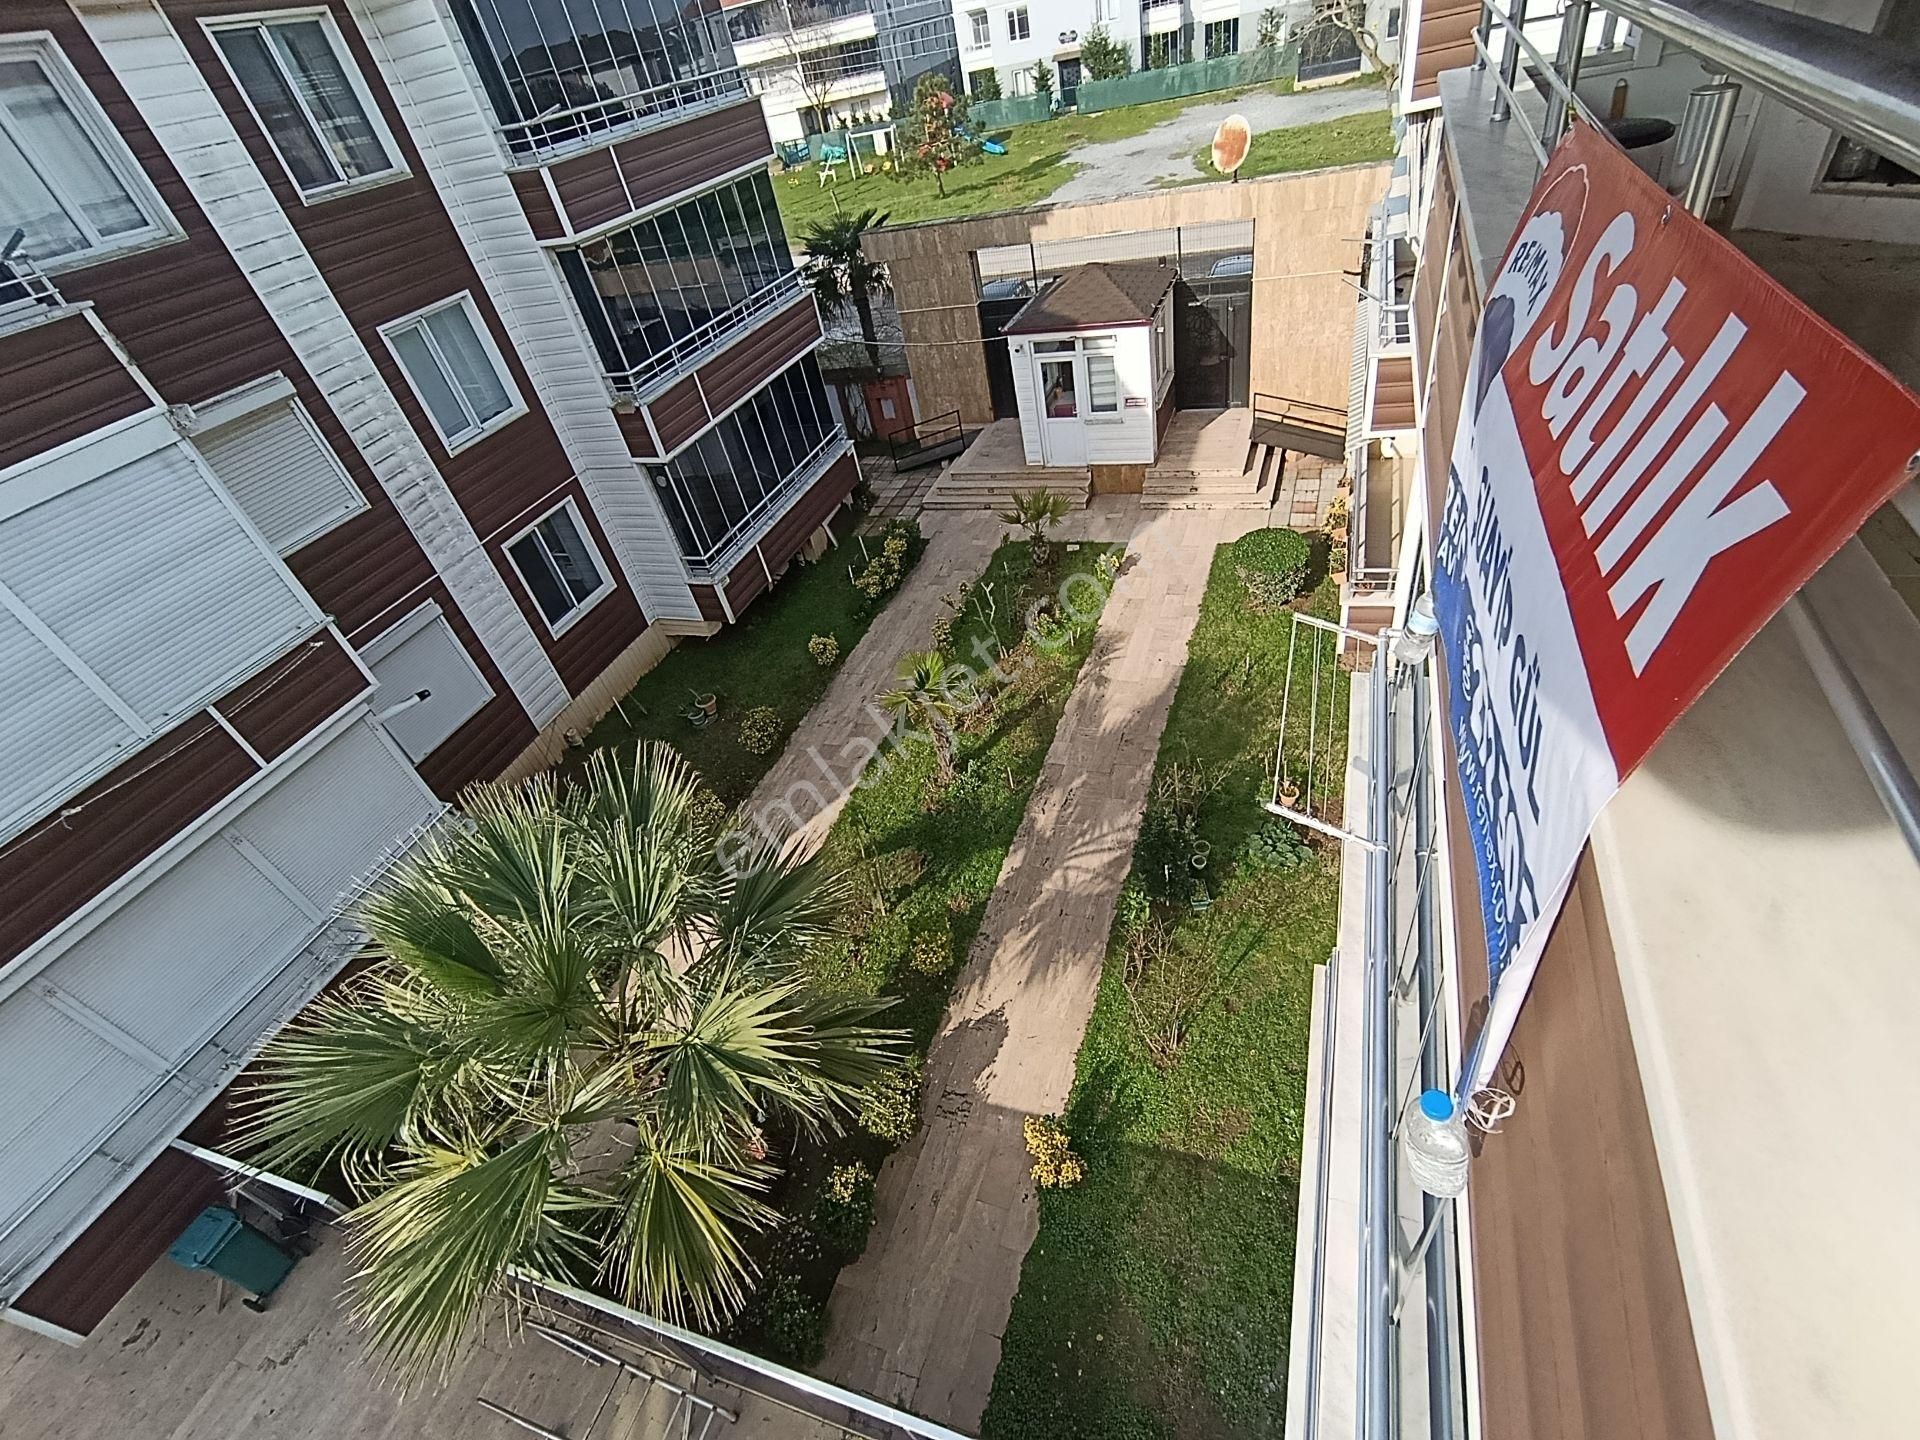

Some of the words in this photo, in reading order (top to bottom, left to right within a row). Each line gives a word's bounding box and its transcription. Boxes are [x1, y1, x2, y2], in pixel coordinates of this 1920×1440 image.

[1507, 240, 1549, 317] RE/MAX
[1529, 211, 1807, 678] Satılık
[1510, 634, 1543, 826] GÜL
